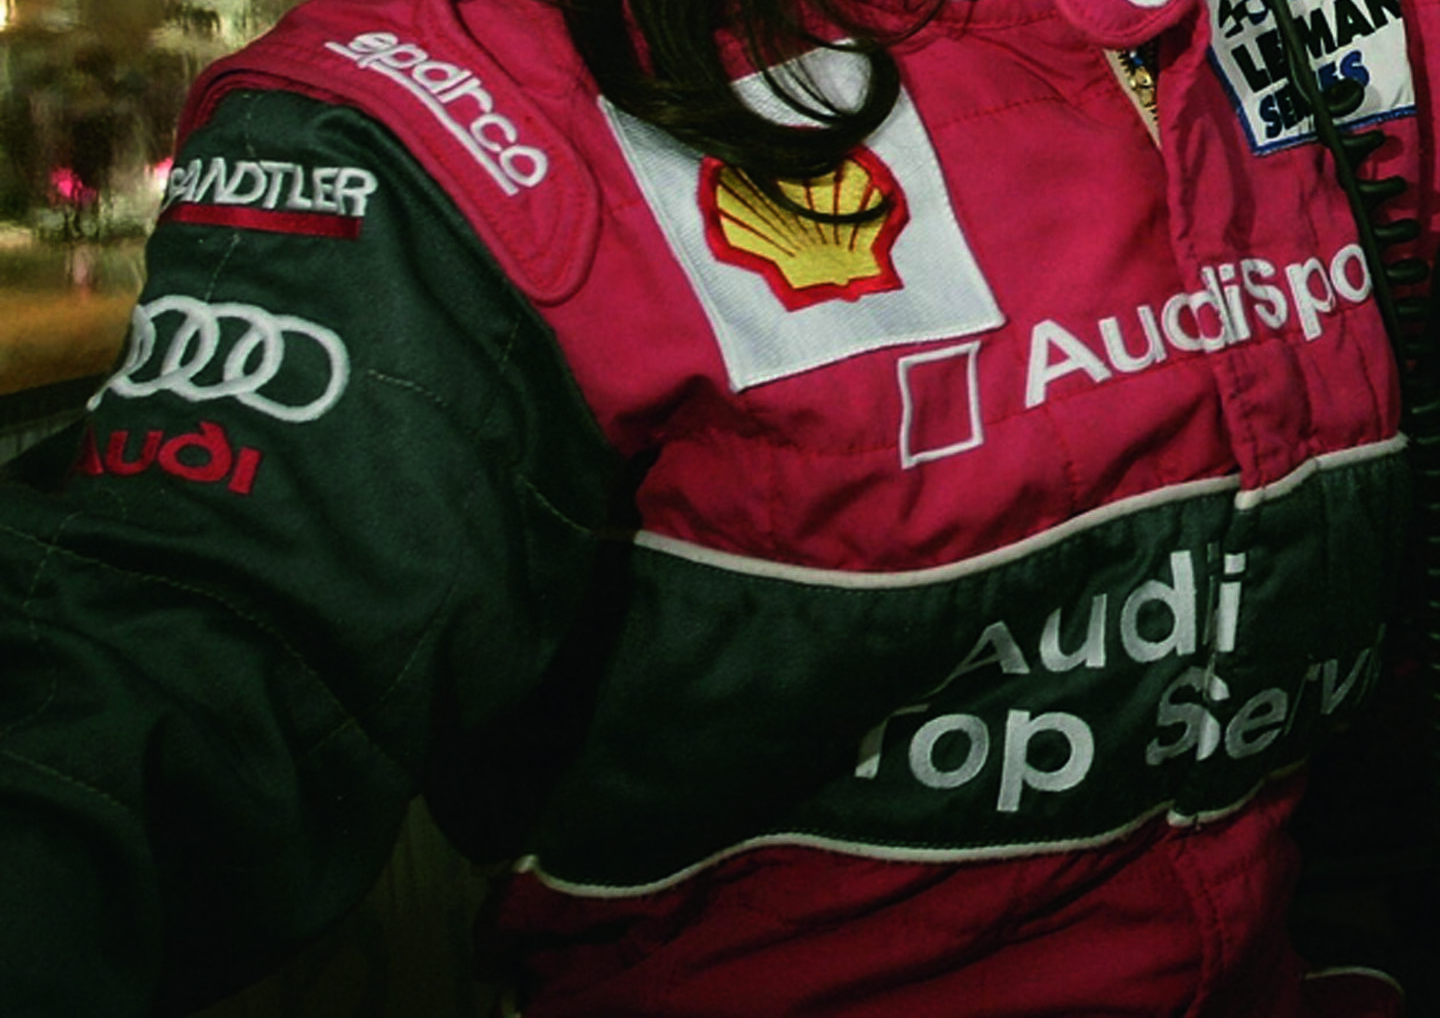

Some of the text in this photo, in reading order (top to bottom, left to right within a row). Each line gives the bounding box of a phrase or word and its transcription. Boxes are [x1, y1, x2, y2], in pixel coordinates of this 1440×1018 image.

[340, 31, 549, 196] sparco
[1024, 242, 1374, 409] AudiSpo
[925, 548, 1248, 696] Audi
